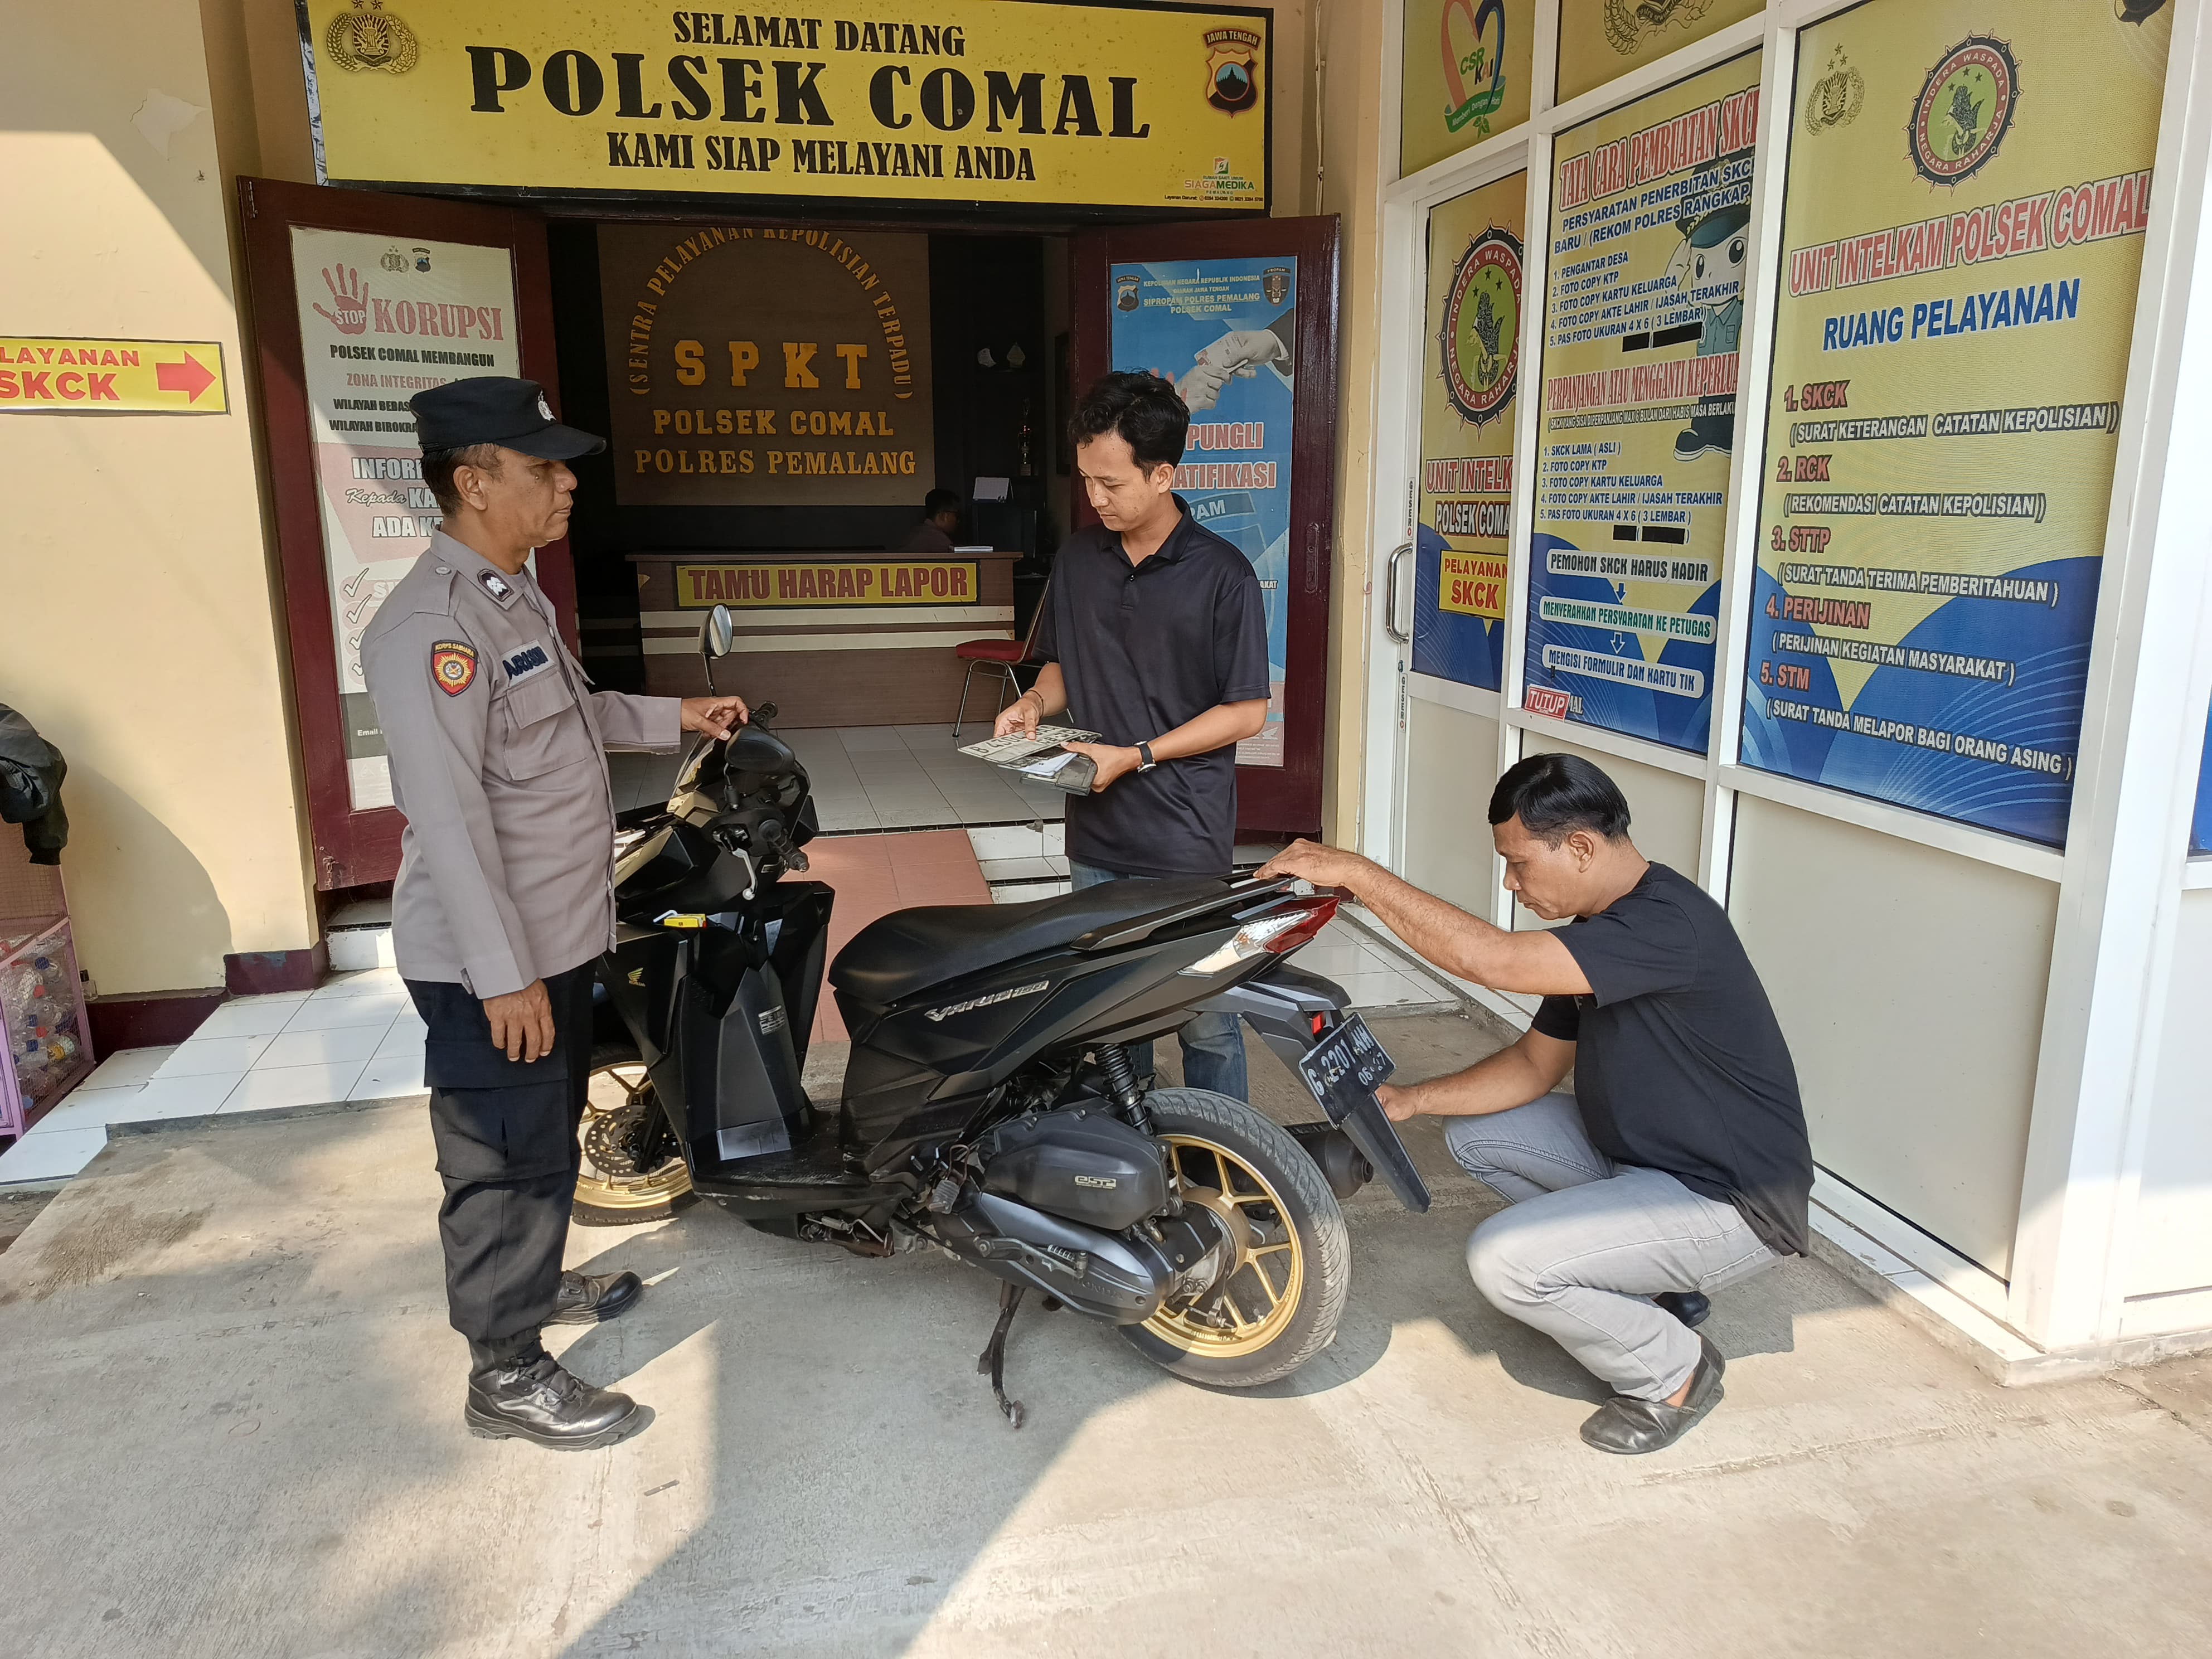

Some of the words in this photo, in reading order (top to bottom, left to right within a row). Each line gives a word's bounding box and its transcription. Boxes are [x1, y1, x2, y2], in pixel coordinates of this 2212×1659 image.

[672, 11, 822, 51] SELAMAT
[835, 20, 966, 57] DATANG
[1207, 31, 1228, 43] JAWA
[1229, 31, 1258, 45] TENGAH
[1460, 47, 1485, 75] CSR
[1474, 58, 1494, 85] KAI
[465, 45, 834, 127] POLSEK
[869, 65, 1151, 139] COMAL
[1923, 62, 1957, 114] INDERA
[1963, 53, 2004, 89] WASPADA
[1919, 133, 1949, 171] NEGARA
[1955, 109, 2003, 169] RAHARJA
[607, 132, 695, 170] KAMI
[706, 136, 779, 173] SIAP
[793, 139, 944, 179] MELAYANI
[954, 145, 1036, 182] ANDA
[1561, 154, 1590, 208] TATA
[1593, 139, 1626, 197] CARA
[1629, 104, 1719, 187] PEMBUATAN
[1185, 180, 1254, 190] SIAGAMEDIKA
[1563, 197, 1637, 232] PERSYARATAN
[1640, 169, 1719, 208] PENERBITAN
[1554, 235, 1581, 254] BARU
[1634, 204, 1681, 232] POLRES
[1684, 184, 1750, 215] RANGKAP
[1791, 243, 1837, 295] UNIT
[1839, 217, 1947, 287] INTELKAM
[1951, 193, 2051, 266] POLSEK
[2053, 172, 2151, 246] COMAL
[1561, 256, 1605, 279] PENGANTAR
[1608, 251, 1628, 266] DESA
[1144, 297, 1183, 306] SIPROPAM
[1185, 295, 1215, 304] POLRES
[1217, 293, 1260, 302] PEMALANG
[1451, 258, 1481, 322] INDERA
[1559, 298, 1578, 312] FOTO
[1580, 293, 1600, 307] COPY
[1602, 285, 1629, 303] KARTU
[1631, 275, 1677, 295] KELUARGA
[1559, 315, 1577, 329] FOTO
[1579, 310, 1599, 324] COPY
[1601, 305, 1622, 320] AKTE
[1624, 299, 1649, 316] LAHIR
[1656, 293, 1688, 309] IJASAH
[1690, 281, 1739, 303] TERAKHIR
[337, 309, 365, 325] STOP
[371, 298, 503, 340] KORUPSI
[1204, 304, 1231, 313] COMAL
[1822, 306, 1904, 352] RUANG
[1911, 278, 2080, 340] PELAYANAN
[1558, 333, 1571, 345] PAS
[1573, 328, 1592, 342] FOTO
[1594, 322, 1627, 339] UKURAN
[330, 345, 375, 360] POLSEK
[379, 347, 419, 363] COMAL
[422, 351, 494, 367] MEMBANGUN
[0, 370, 120, 401] SKCK
[347, 373, 377, 387] ZONA
[1449, 347, 1476, 405] NEGARA
[1546, 370, 1607, 412] PERPANJANGAN
[1609, 367, 1630, 406] ATAU
[1632, 359, 1685, 402] MENGGANTI
[333, 399, 377, 410] WILAYAH
[379, 401, 409, 412] BEBAS
[1801, 380, 1850, 410] SKCK
[329, 420, 373, 432] WILAYAH
[653, 409, 776, 435] POLSEK
[790, 411, 893, 436] COMAL
[1624, 411, 1634, 423] MAX
[1640, 410, 1657, 422] BULAN
[1658, 409, 1671, 420] DARI
[1672, 406, 1690, 418] HABIS
[1691, 404, 1707, 416] MASA
[1839, 415, 1927, 440] KETERANGAN
[1932, 411, 2000, 436] CATATAN
[2003, 404, 2107, 433] KEPOLISIAN
[1186, 423, 1263, 450] PUNGLI
[1551, 444, 1570, 456] SKCK
[1572, 443, 1592, 455] LAMA
[1599, 442, 1616, 454] ASLI
[635, 449, 755, 474] POLRES
[768, 451, 916, 475] PEMALANG
[1427, 460, 1457, 493] UNIT
[1795, 455, 1832, 482] RCK
[346, 488, 406, 507] Kepada
[1879, 494, 1939, 515] CATATAN
[372, 516, 417, 537] ADA
[1435, 502, 1477, 536] POLSEK
[1789, 528, 1831, 553] STTP
[1551, 553, 1597, 573] PEMOHON
[1600, 557, 1627, 575] SKCK
[1631, 559, 1667, 578] HARUS
[1671, 562, 1708, 581] HADIR
[688, 569, 770, 600] TAMU
[778, 568, 873, 599] HARAP
[880, 566, 968, 597] LAPOR
[1451, 579, 1499, 610] SKCK
[1784, 565, 1823, 586] SURAT
[1825, 568, 1866, 588] TANDA
[1869, 570, 1917, 593] TERIMA
[1920, 574, 2049, 603] PEMBERITAHUAN
[1543, 601, 1597, 621] MENYERAHKAN
[1598, 608, 1653, 629] PERSYARATAN
[1656, 615, 1666, 632] KE
[1670, 616, 1710, 638] PETUGAS
[1783, 597, 1871, 629] PERIJINAN
[1549, 649, 1581, 668] MENGISI
[1583, 656, 1624, 677] FORMULIR
[1627, 664, 1645, 681] DAN
[1647, 667, 1676, 687] KARTU
[1680, 673, 1695, 691] TIK
[1779, 633, 1840, 657] PERIJINAN
[1841, 639, 1906, 667] KEGIATAN
[1908, 650, 2007, 681] MASYARAKAT
[1777, 666, 1810, 691] STM
[1530, 690, 1565, 714] TUTUP
[1773, 698, 1810, 720] SURAT
[1812, 706, 1850, 730] TANDA
[1853, 714, 1914, 743] MELAPOR
[1917, 726, 1951, 752] BAGI
[1954, 735, 2008, 763] ORANG
[2010, 746, 2064, 774] ASING
[1308, 1069, 1325, 1096] G
